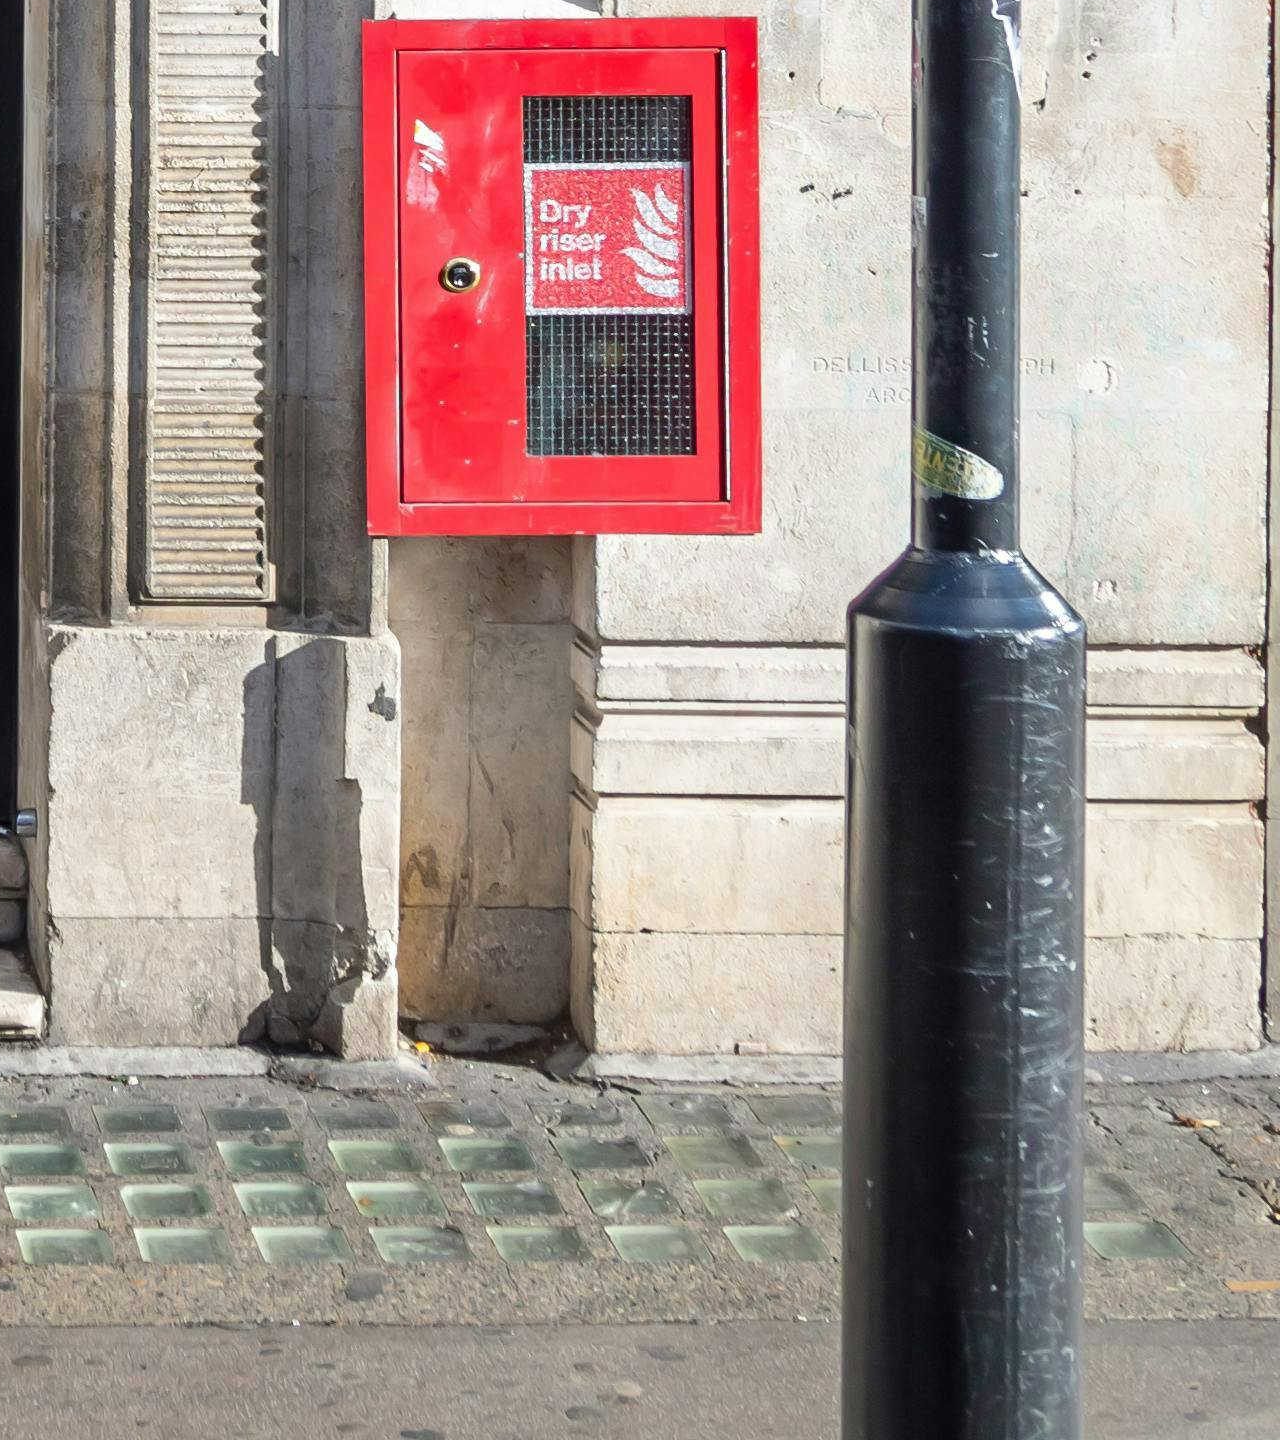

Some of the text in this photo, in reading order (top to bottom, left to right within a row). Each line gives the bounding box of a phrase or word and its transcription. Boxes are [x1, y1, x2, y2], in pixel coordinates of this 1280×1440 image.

[540, 200, 590, 228] Dry
[540, 230, 607, 253] riser
[539, 257, 602, 282] inlet
